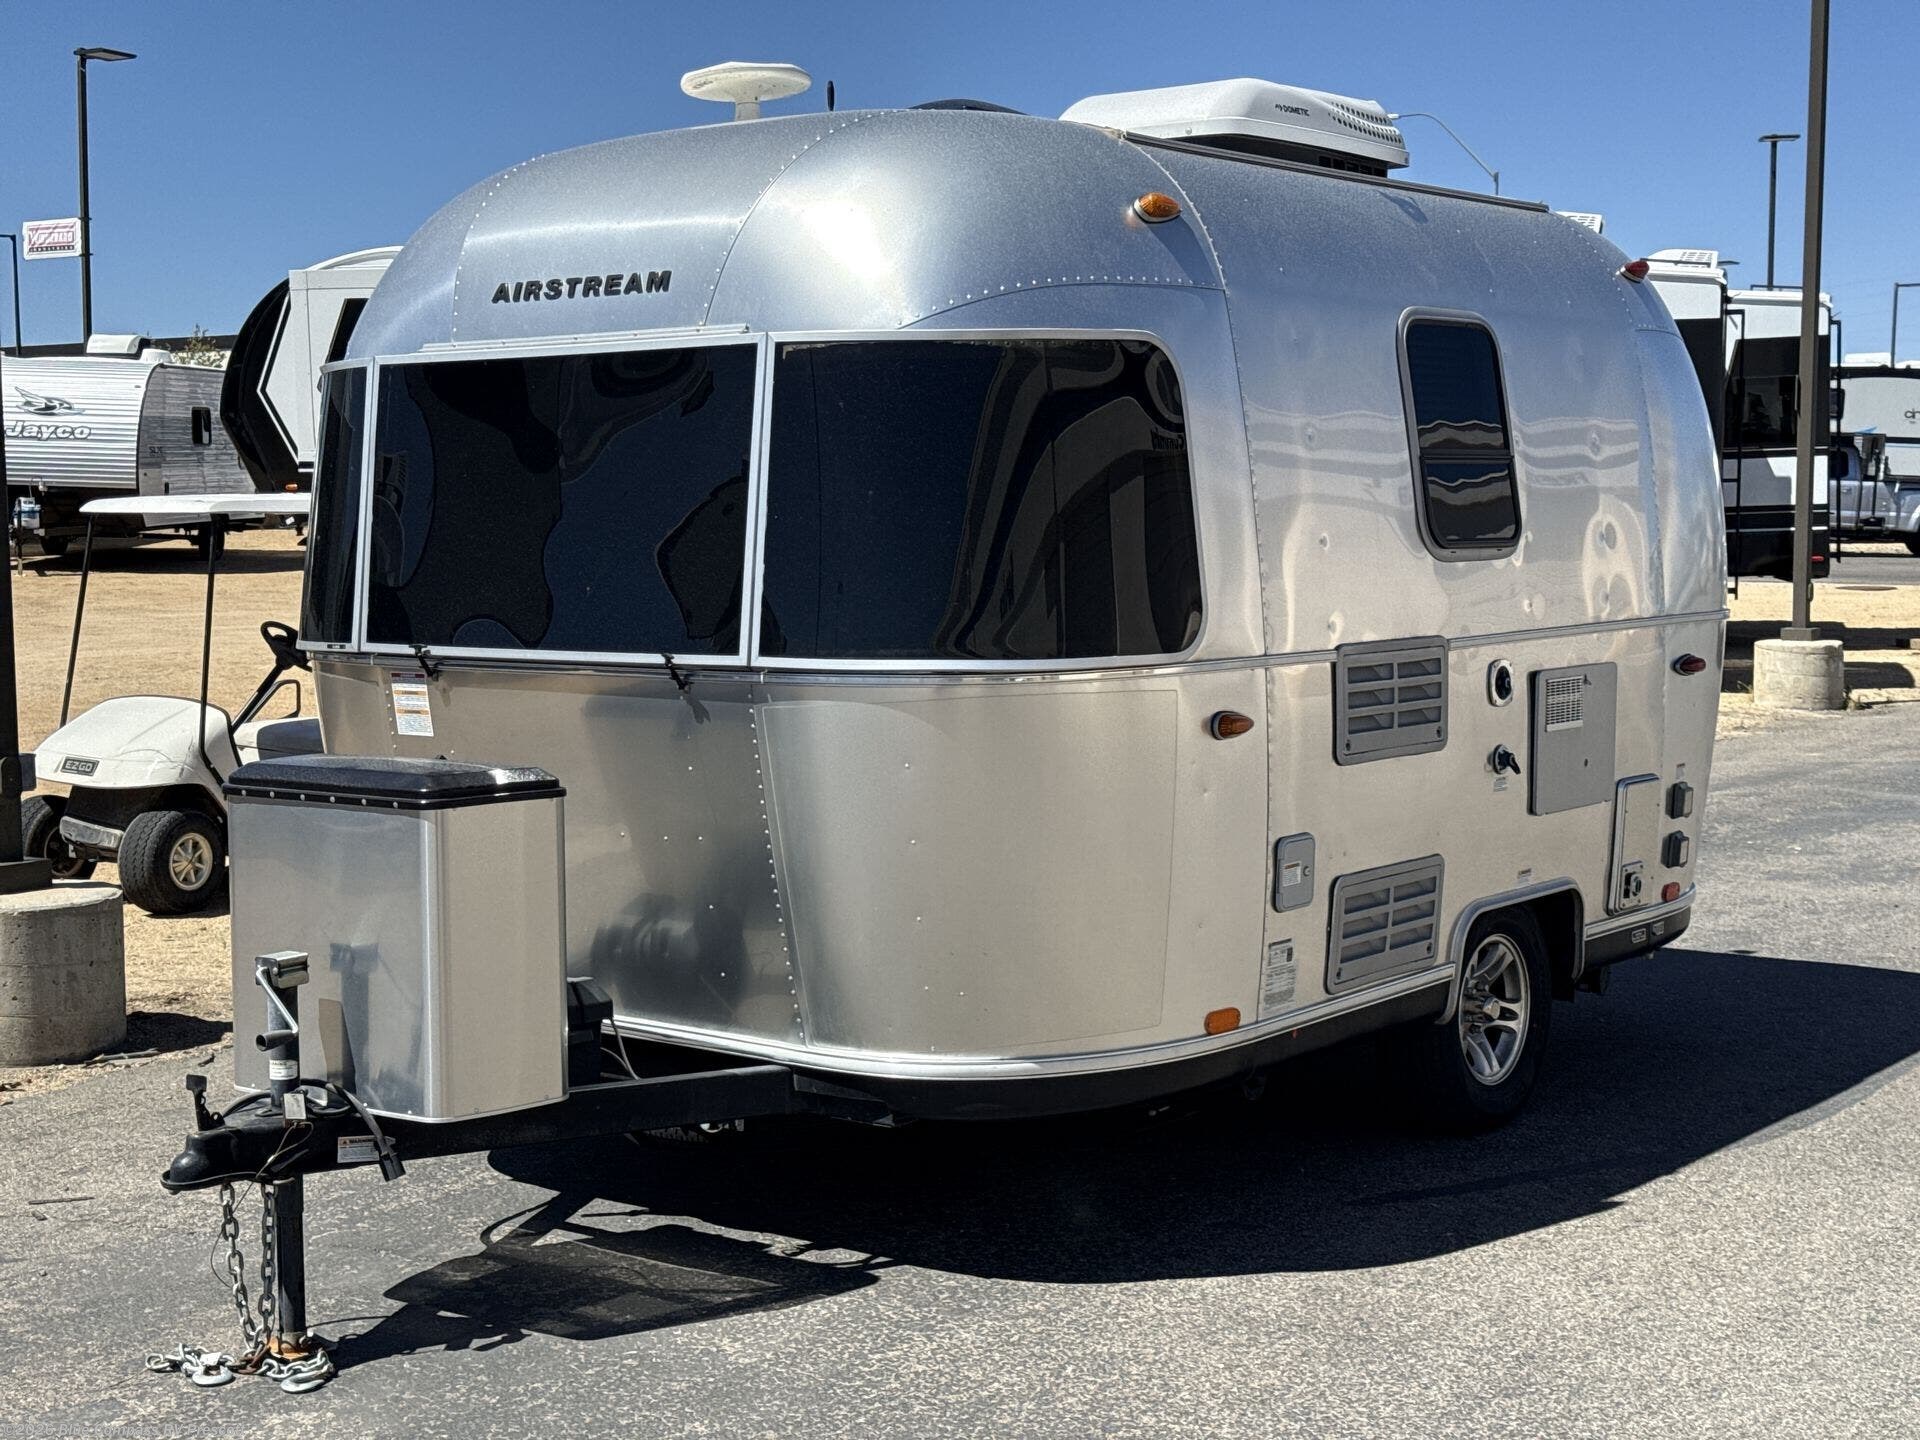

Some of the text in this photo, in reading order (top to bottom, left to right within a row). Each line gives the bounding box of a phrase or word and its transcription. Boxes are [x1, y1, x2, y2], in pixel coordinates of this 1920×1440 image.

[1283, 104, 1310, 116] DOMETIC
[491, 270, 672, 304] AIRSTREAM
[5, 420, 91, 441] Jayco
